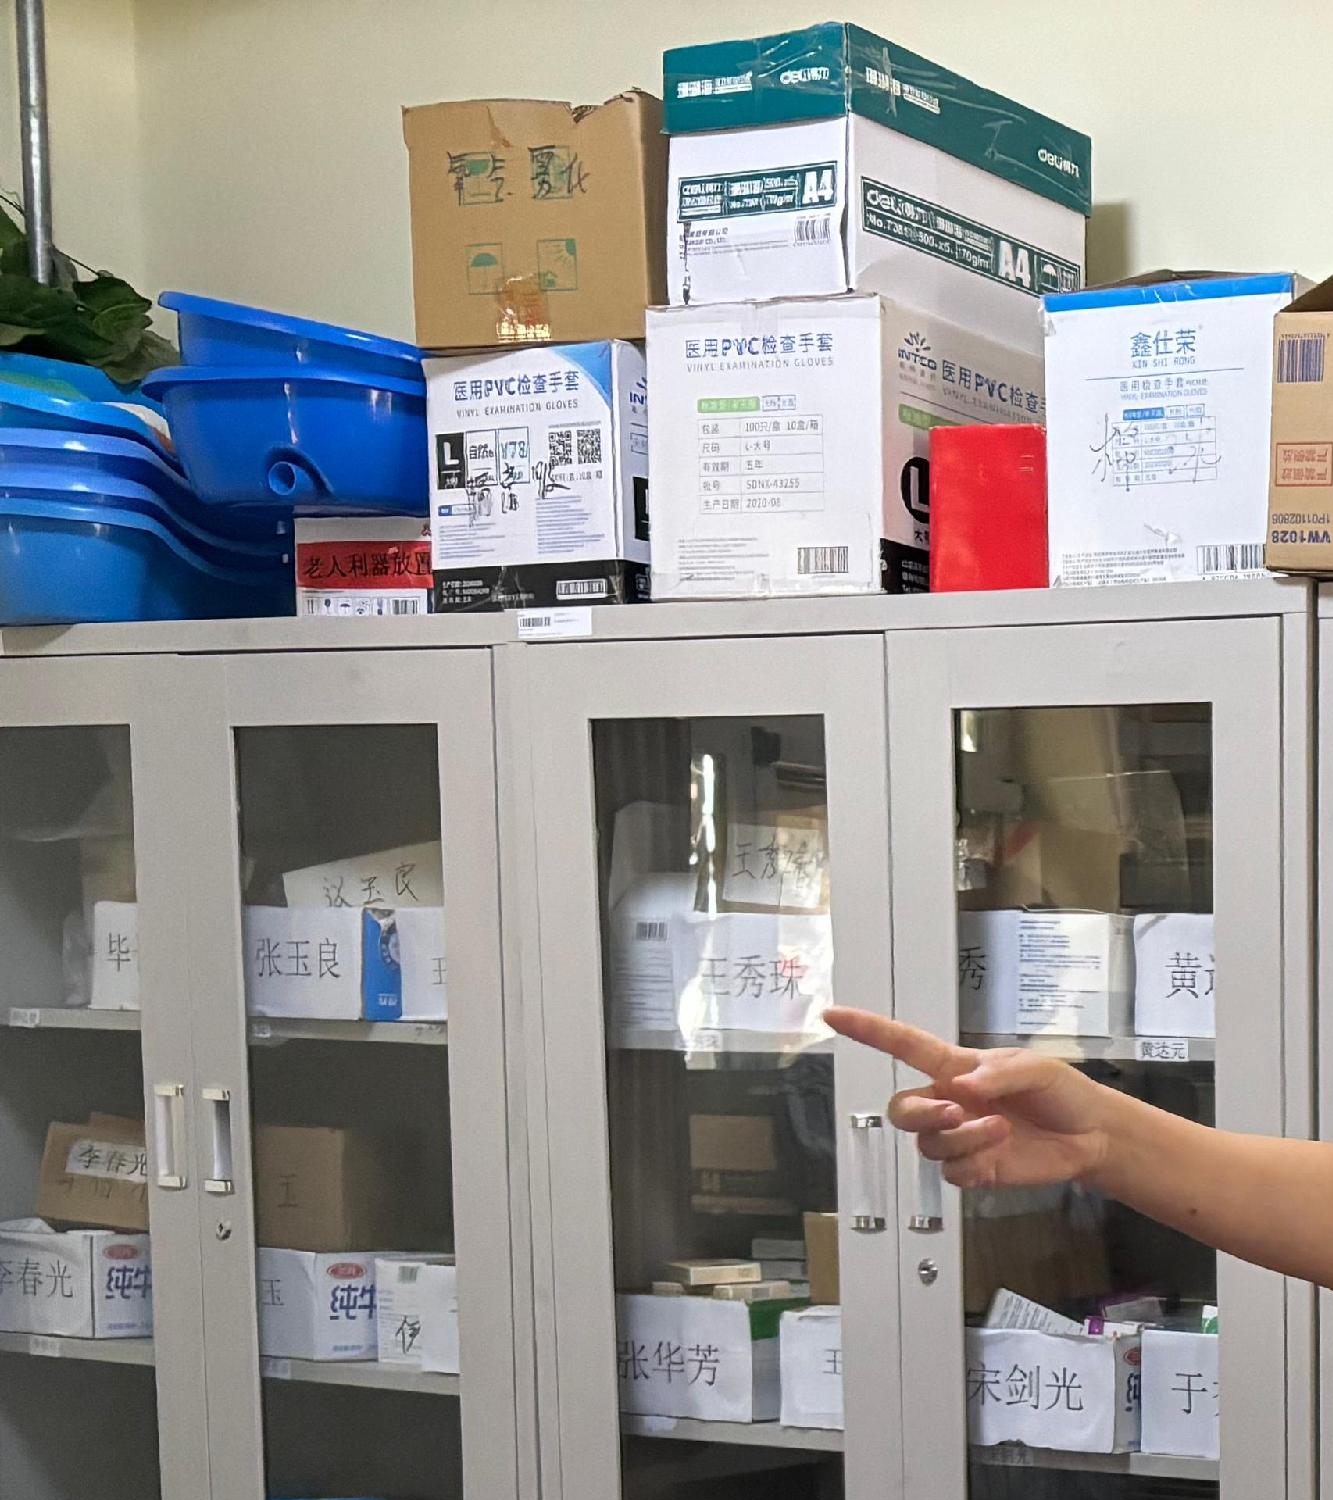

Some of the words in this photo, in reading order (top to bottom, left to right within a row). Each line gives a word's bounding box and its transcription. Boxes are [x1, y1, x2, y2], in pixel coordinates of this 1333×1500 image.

[802, 170, 833, 203] A4
[1001, 240, 1030, 288] A4
[686, 333, 833, 358] 医用PVC检查手套
[1130, 329, 1196, 358] 鑫仕荣
[687, 363, 715, 373] VINYL
[720, 359, 789, 371] EXAMINATION
[794, 356, 833, 367] GLOVES
[898, 348, 937, 370] INTCO
[453, 370, 579, 401] 医用PVC检查手套
[545, 399, 578, 410] GLOVES
[443, 441, 459, 465] L
[703, 499, 740, 510] 生产日期
[1272, 529, 1331, 544] VW1028
[107, 932, 131, 972] 毕
[256, 937, 341, 979] 张玉良
[618, 1341, 720, 1386] 张华芳
[967, 1362, 1084, 1411] 宋剑光
